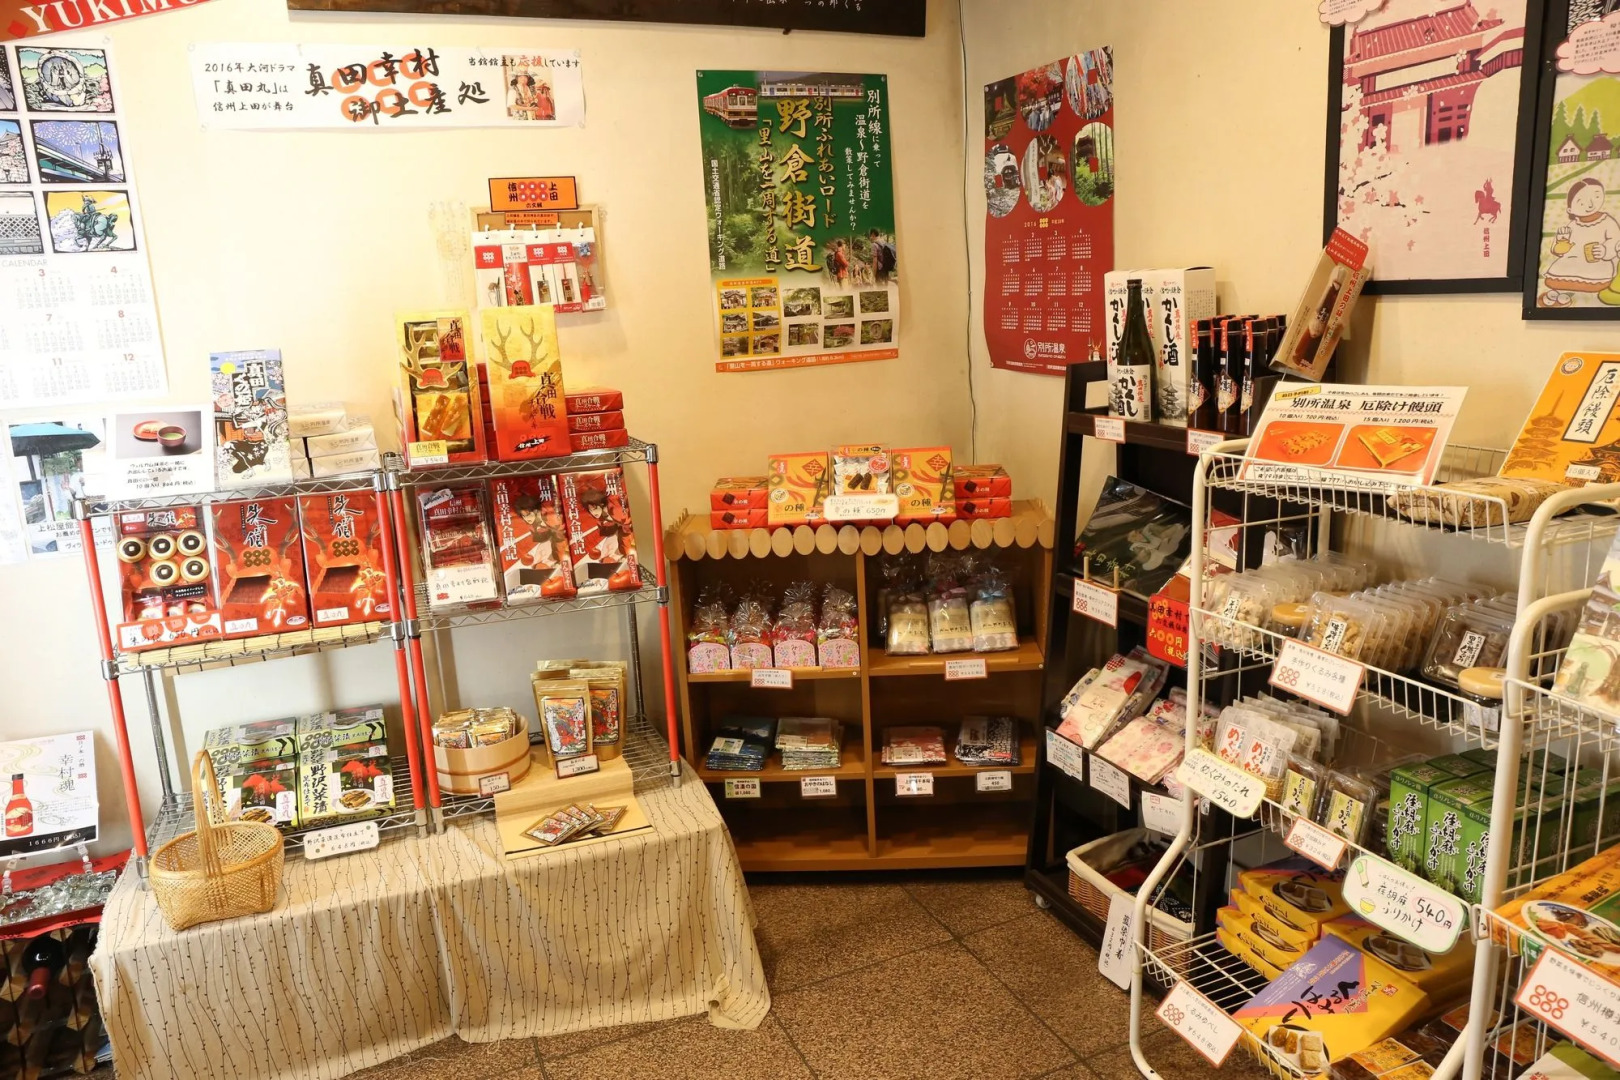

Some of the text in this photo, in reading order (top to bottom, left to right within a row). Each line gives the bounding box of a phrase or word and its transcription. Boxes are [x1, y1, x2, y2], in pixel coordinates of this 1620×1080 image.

[204, 62, 296, 74] 2016年大河ドラマ
[304, 47, 440, 97] 真田幸村
[214, 79, 289, 95] 「真田丸」は
[213, 101, 294, 112] 信州上田が舞台
[349, 80, 491, 126] 御土産処
[866, 89, 884, 169] 別所線に乗って
[813, 95, 837, 230] 別所ふれあいロード
[508, 181, 519, 203] 信州
[548, 181, 559, 202] 上田
[757, 118, 782, 273] 「里山を一周する道」
[776, 98, 824, 273] 野倉街道
[1483, 227, 1491, 259] 信州上田
[38, 268, 46, 277] 3
[110, 266, 118, 274] 4
[46, 313, 53, 322] 7
[118, 310, 125, 318] 8
[1161, 296, 1180, 368] かくし酒
[52, 358, 63, 366] 11
[123, 353, 135, 361] 12
[1037, 341, 1066, 354] 別所温泉
[250, 362, 265, 388] 真田
[535, 371, 558, 421] 真田合戦
[1291, 397, 1444, 413] 別所温泉 厄除け饅頭
[1574, 368, 1619, 436] 厄除饅頭
[806, 458, 824, 475] 幸
[928, 454, 948, 470] 幸
[537, 478, 552, 502] 信州
[604, 472, 619, 497] 信州
[495, 482, 519, 562] 真田幸村合戦記
[563, 475, 587, 556] 真田幸村合戦記
[1291, 656, 1346, 684] 手作りくるみ各種
[57, 753, 76, 792] 幸村魂
[310, 763, 329, 815] 野沢菜漬
[1391, 803, 1402, 850] ふりかけ
[1427, 821, 1441, 870] ふりかけ
[1463, 842, 1477, 893] ふりかけ
[1381, 905, 1424, 933] ふりかけ
[1415, 898, 1453, 930] 540円
[1184, 1003, 1219, 1034] くるみゆべし
[1580, 1017, 1618, 1047] ¥540
